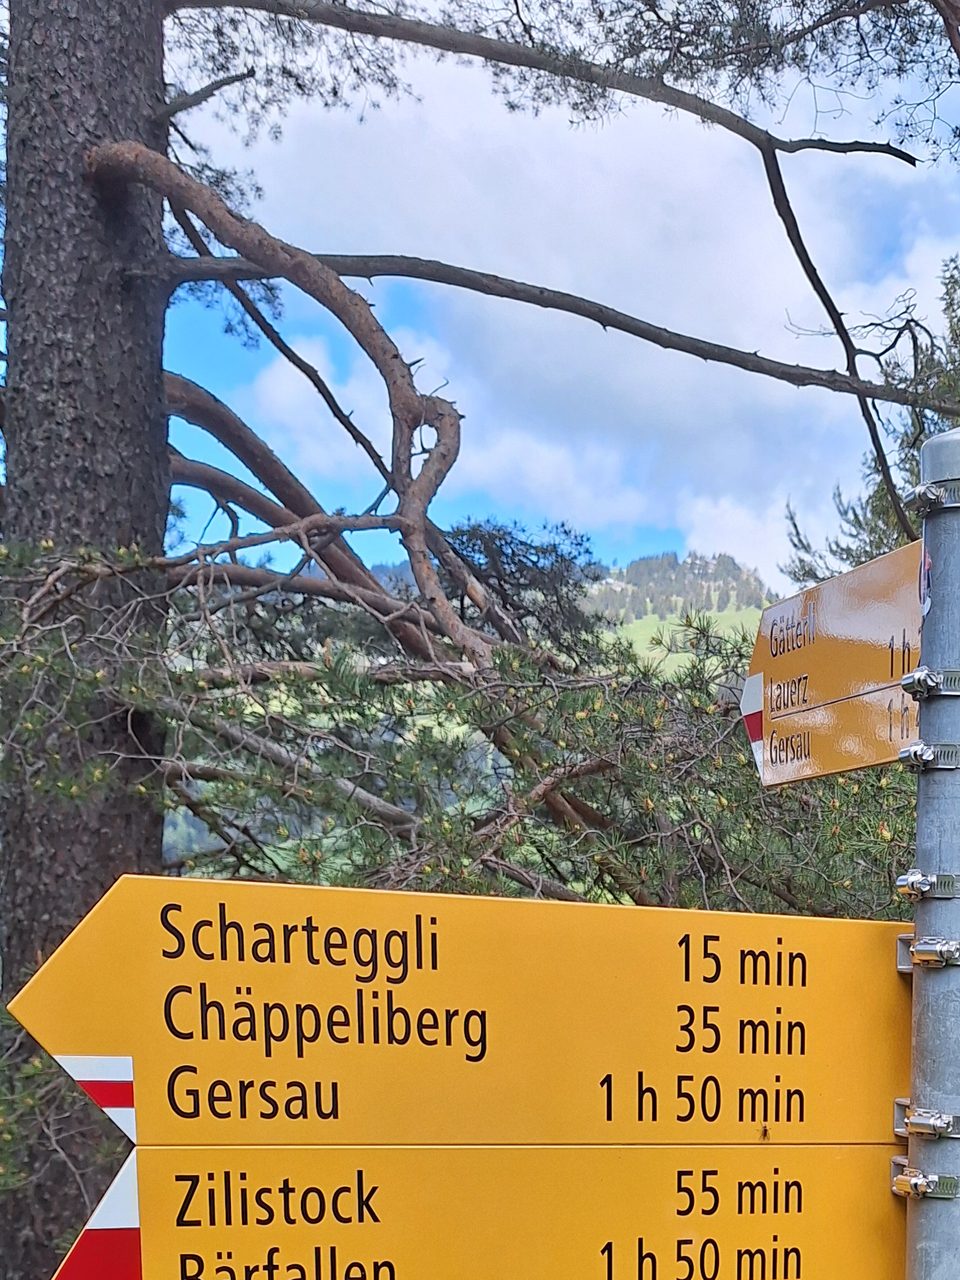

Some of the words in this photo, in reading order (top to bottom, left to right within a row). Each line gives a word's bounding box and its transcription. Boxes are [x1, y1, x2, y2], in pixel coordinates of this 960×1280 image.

[770, 673, 809, 712] Lauerz
[888, 635, 896, 678] 1
[901, 628, 911, 675] h
[770, 730, 811, 767] Gersau
[900, 693, 909, 740] h
[160, 902, 438, 984] Scharteggli
[677, 933, 722, 984] 15
[739, 937, 807, 988] min
[163, 981, 487, 1062] Chäppeliberg
[675, 1004, 721, 1054] 35
[739, 1006, 806, 1056] min
[167, 1064, 339, 1120] Gersau
[599, 1073, 613, 1122] 1
[637, 1070, 658, 1122] h
[676, 1075, 722, 1123] 50
[738, 1075, 805, 1123] min
[174, 1169, 381, 1227] Zilistock
[676, 1169, 720, 1217] 55
[737, 1167, 803, 1215] min
